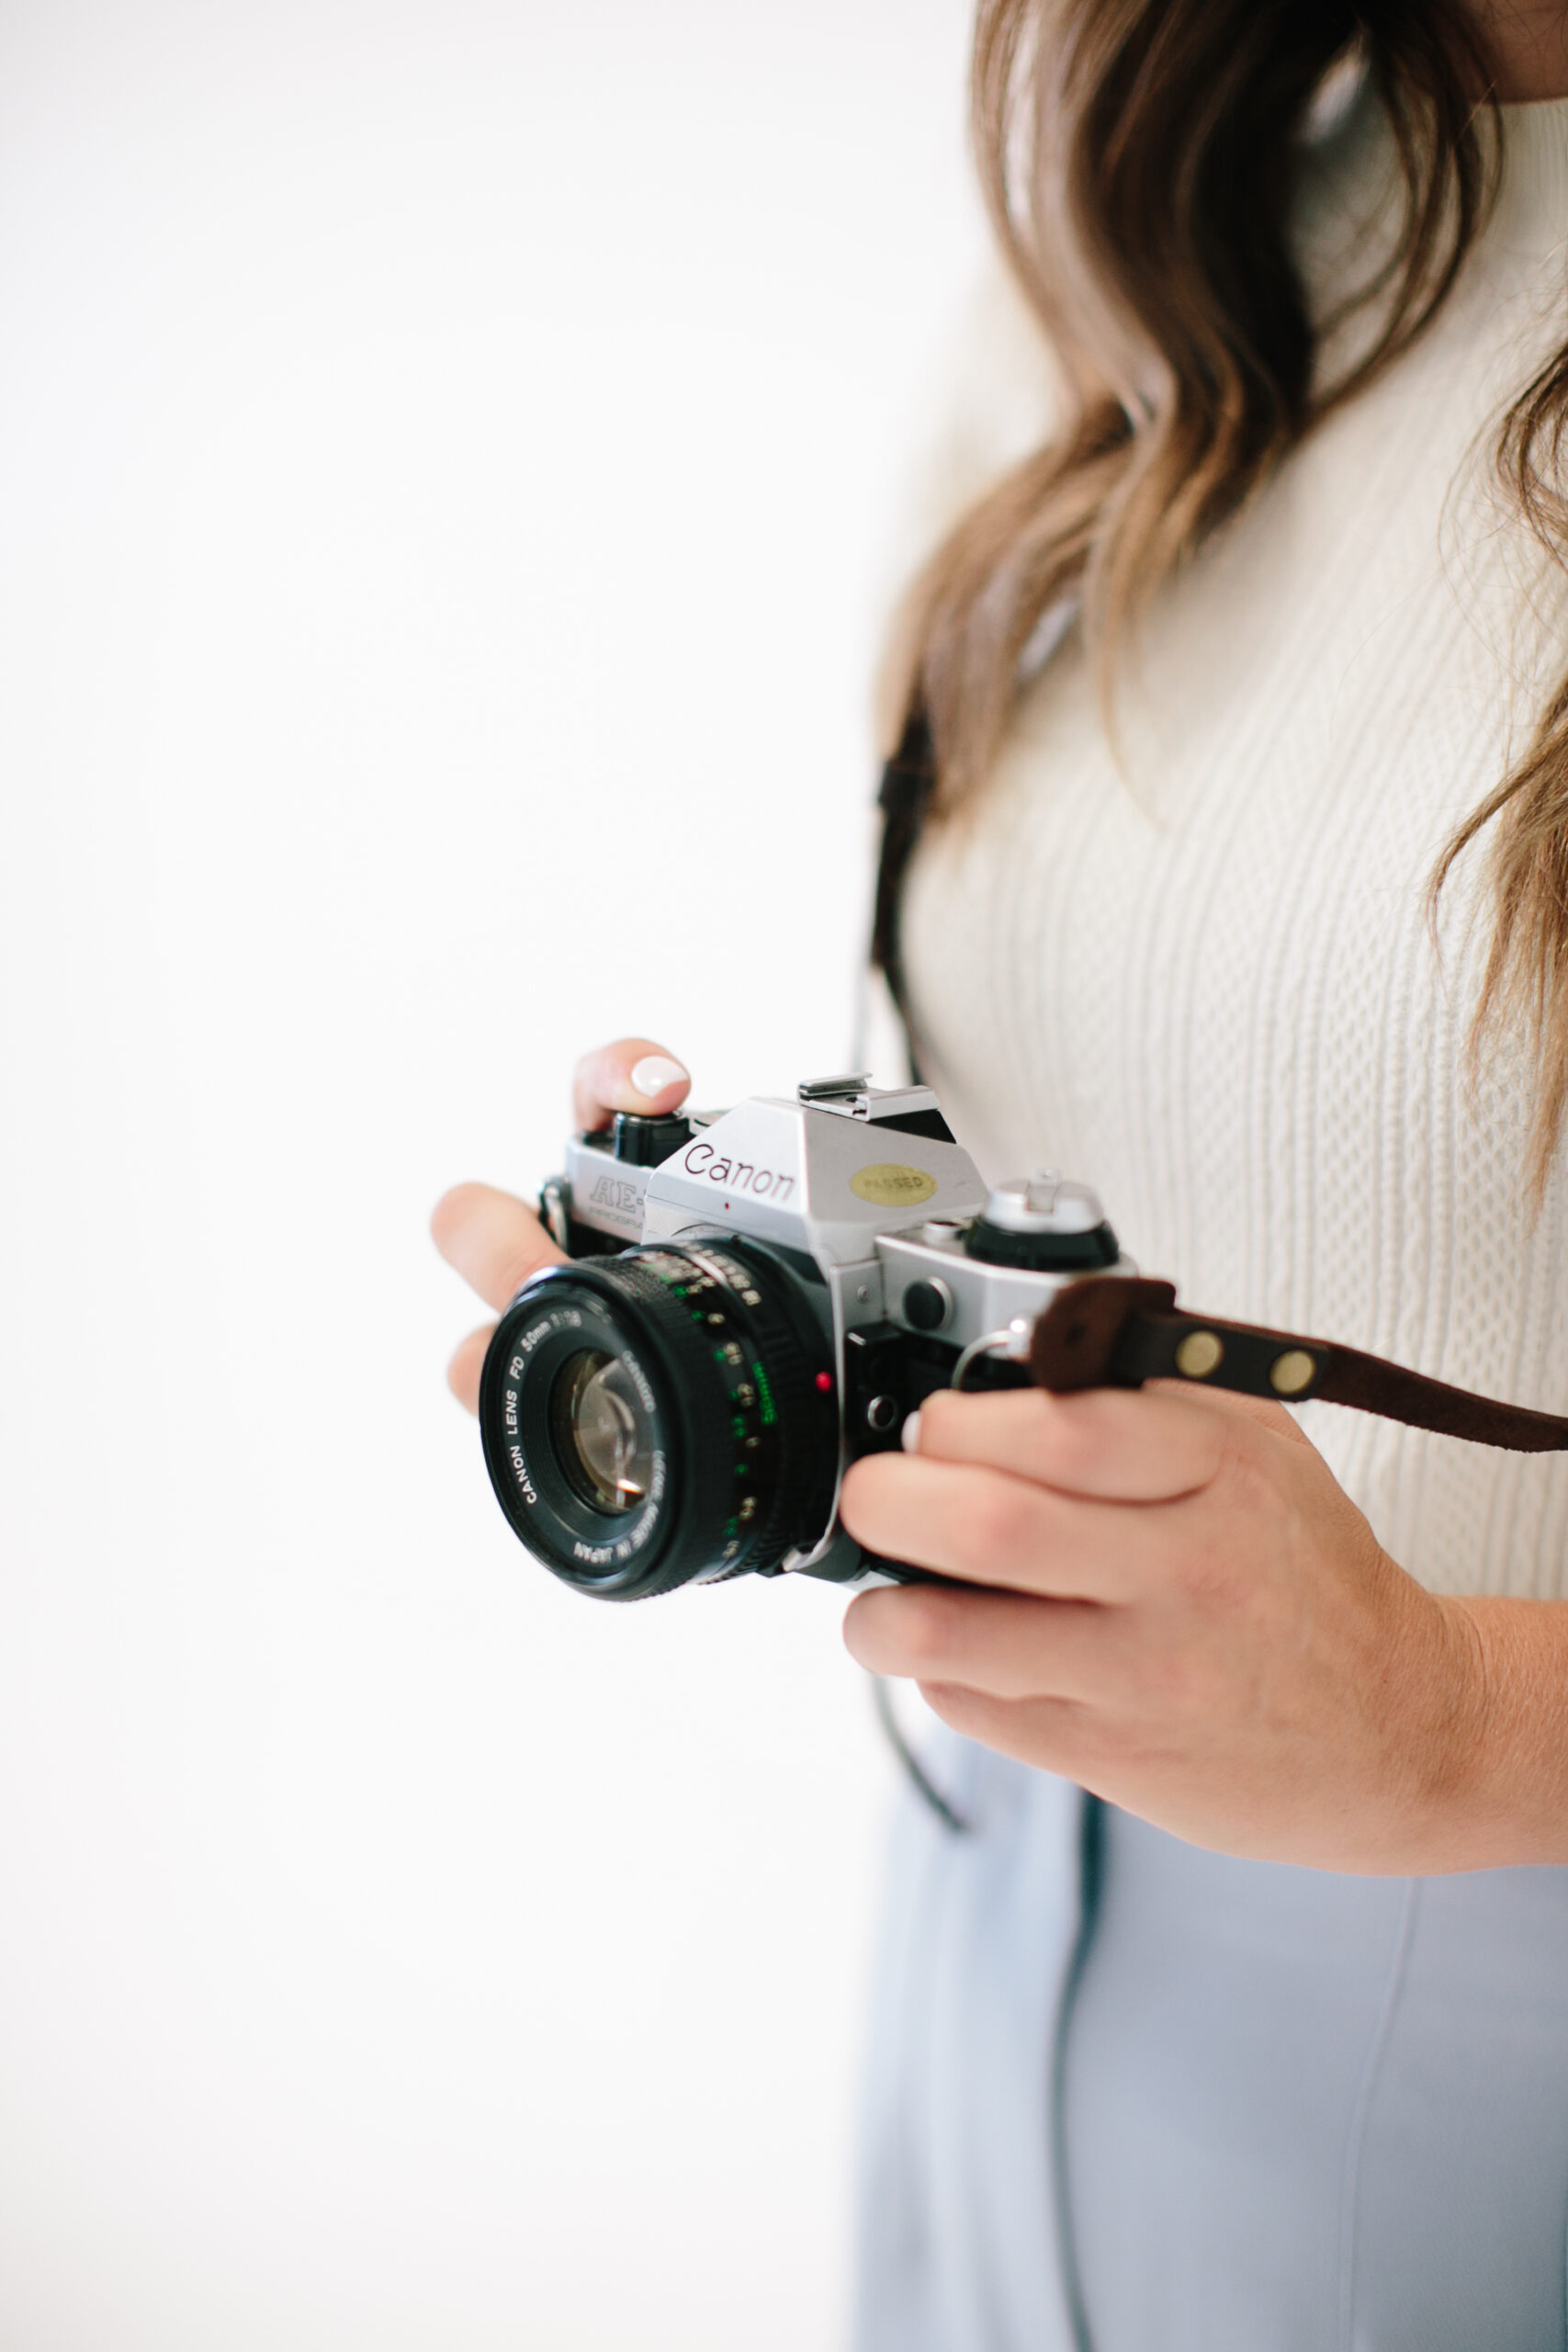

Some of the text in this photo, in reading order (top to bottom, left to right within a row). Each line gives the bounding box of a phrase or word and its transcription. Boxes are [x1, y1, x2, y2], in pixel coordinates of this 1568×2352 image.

[684, 1143, 795, 1202] Canon
[589, 1175, 648, 1217] AE-
[520, 1319, 551, 1352] 50mm
[509, 1356, 525, 1381] FD
[505, 1389, 518, 1435] LENS
[511, 1445, 538, 1505] CANON
[573, 1541, 614, 1564] JAPAN
